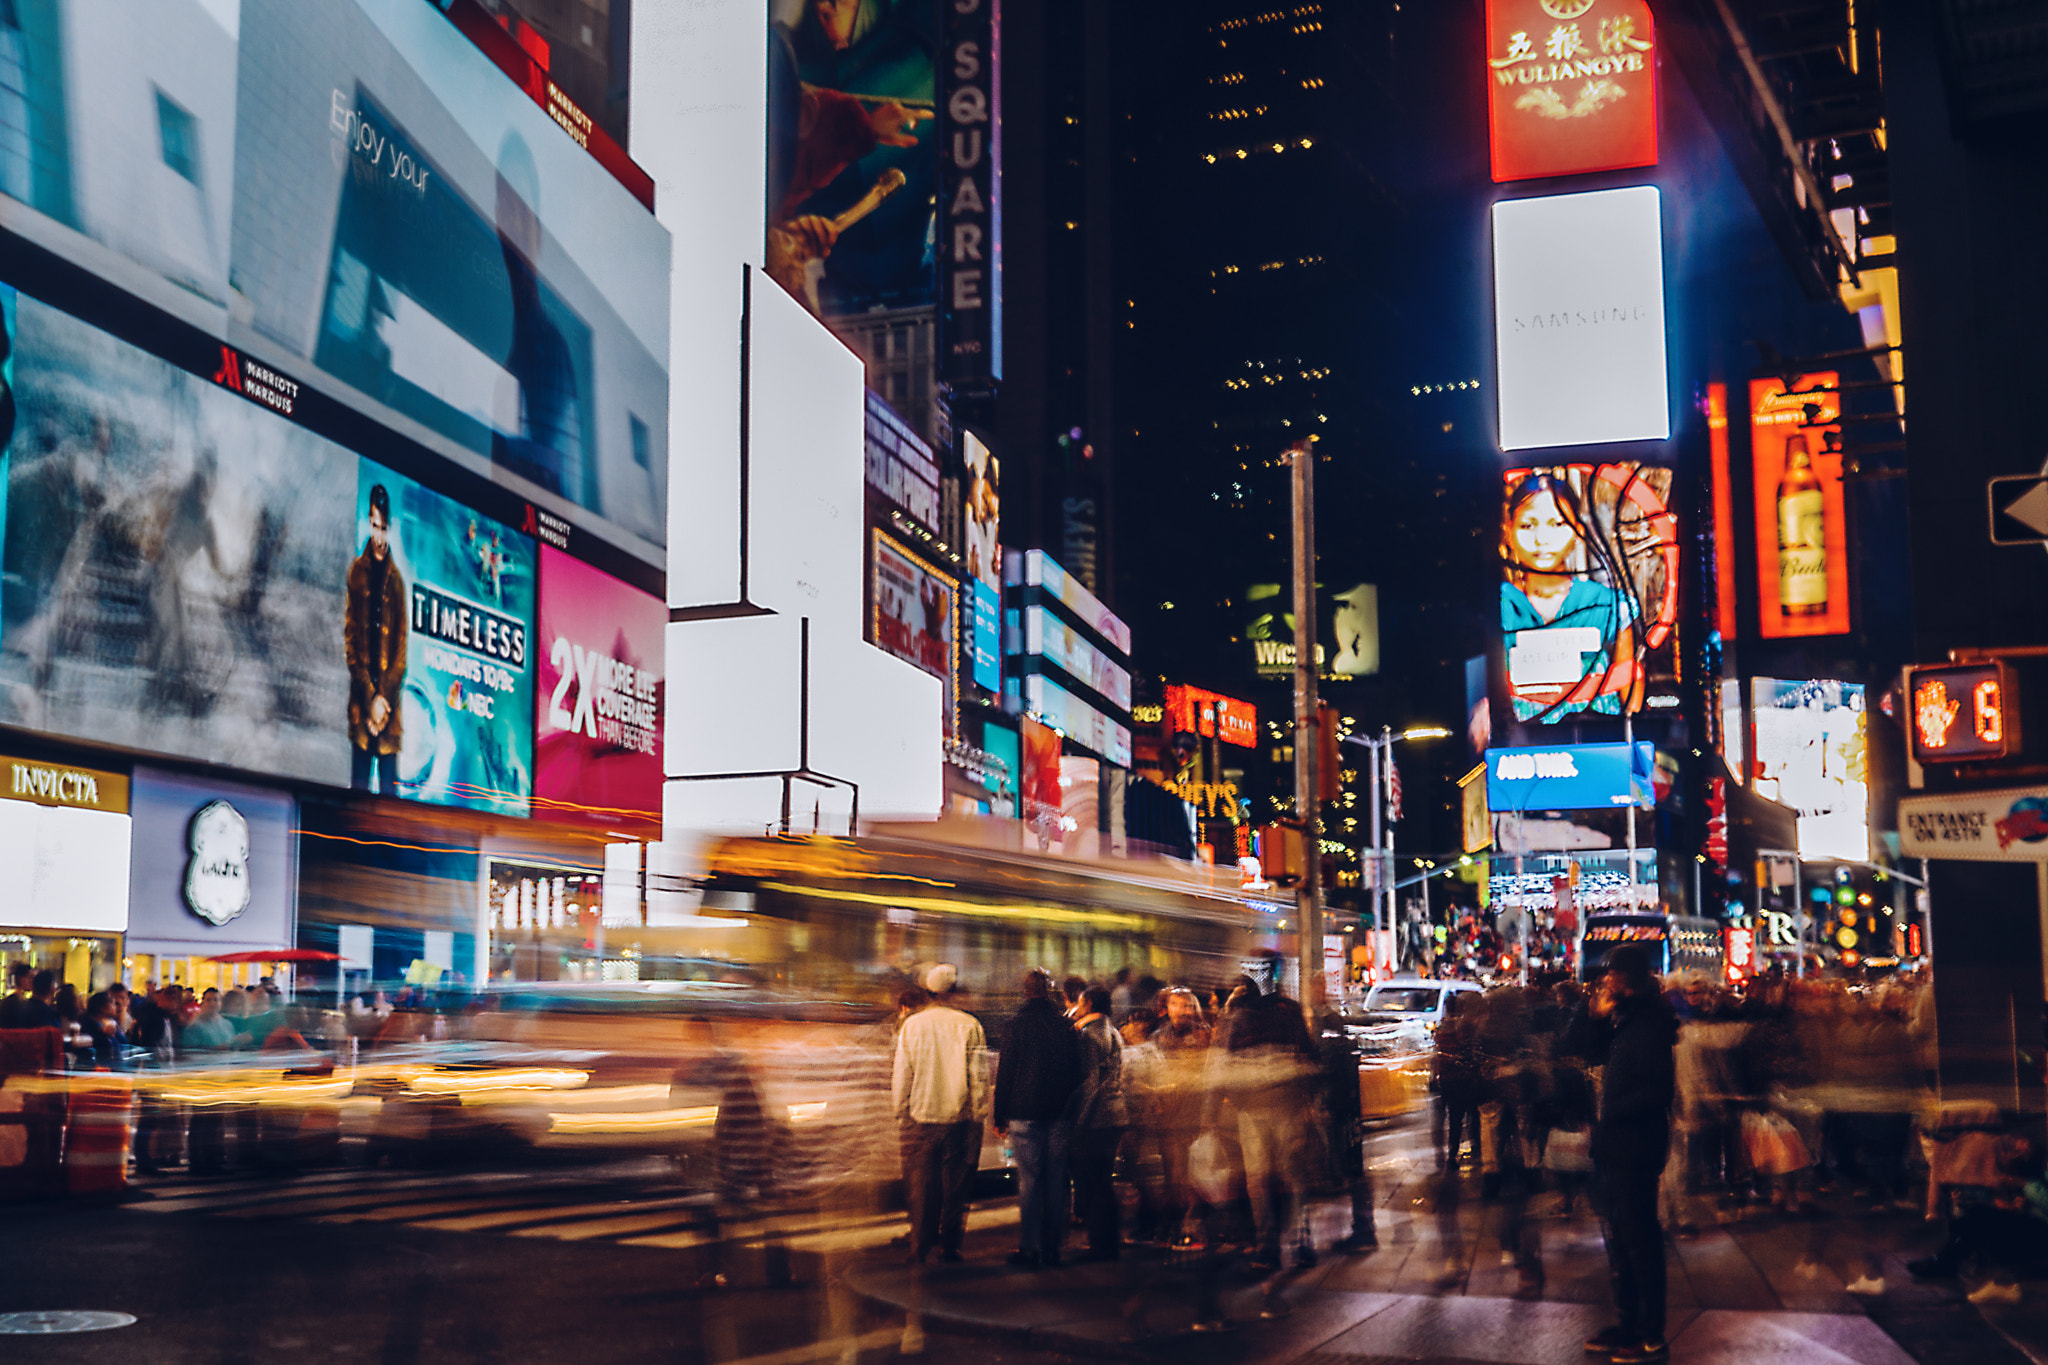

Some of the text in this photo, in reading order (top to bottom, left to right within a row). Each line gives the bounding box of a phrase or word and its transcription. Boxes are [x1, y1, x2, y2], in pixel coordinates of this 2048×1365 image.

[1495, 53, 1643, 86] WULIANGYE
[548, 80, 592, 134] MARRIOTT
[548, 101, 587, 149] MARQUIS
[329, 87, 385, 165] Enjoy
[390, 144, 429, 193] your
[949, 42, 988, 311] SQUARE
[245, 378, 292, 415] MARQUIS
[246, 360, 299, 399] MARRIOTT
[539, 511, 571, 536] MARRIOTT
[539, 526, 567, 549] MARQUIS
[414, 592, 525, 663] TIMELESS
[550, 637, 598, 739] 2X
[598, 655, 634, 695] MORE
[467, 692, 494, 719] NBC
[598, 688, 656, 732] COVERAGE
[1973, 680, 2003, 743] 6
[597, 716, 624, 746] THAN
[12, 764, 98, 804] INVICTA
[1907, 811, 1986, 829] ENTRANCE
[1914, 826, 1982, 842] ON 45TH
[1767, 912, 1800, 945] R
